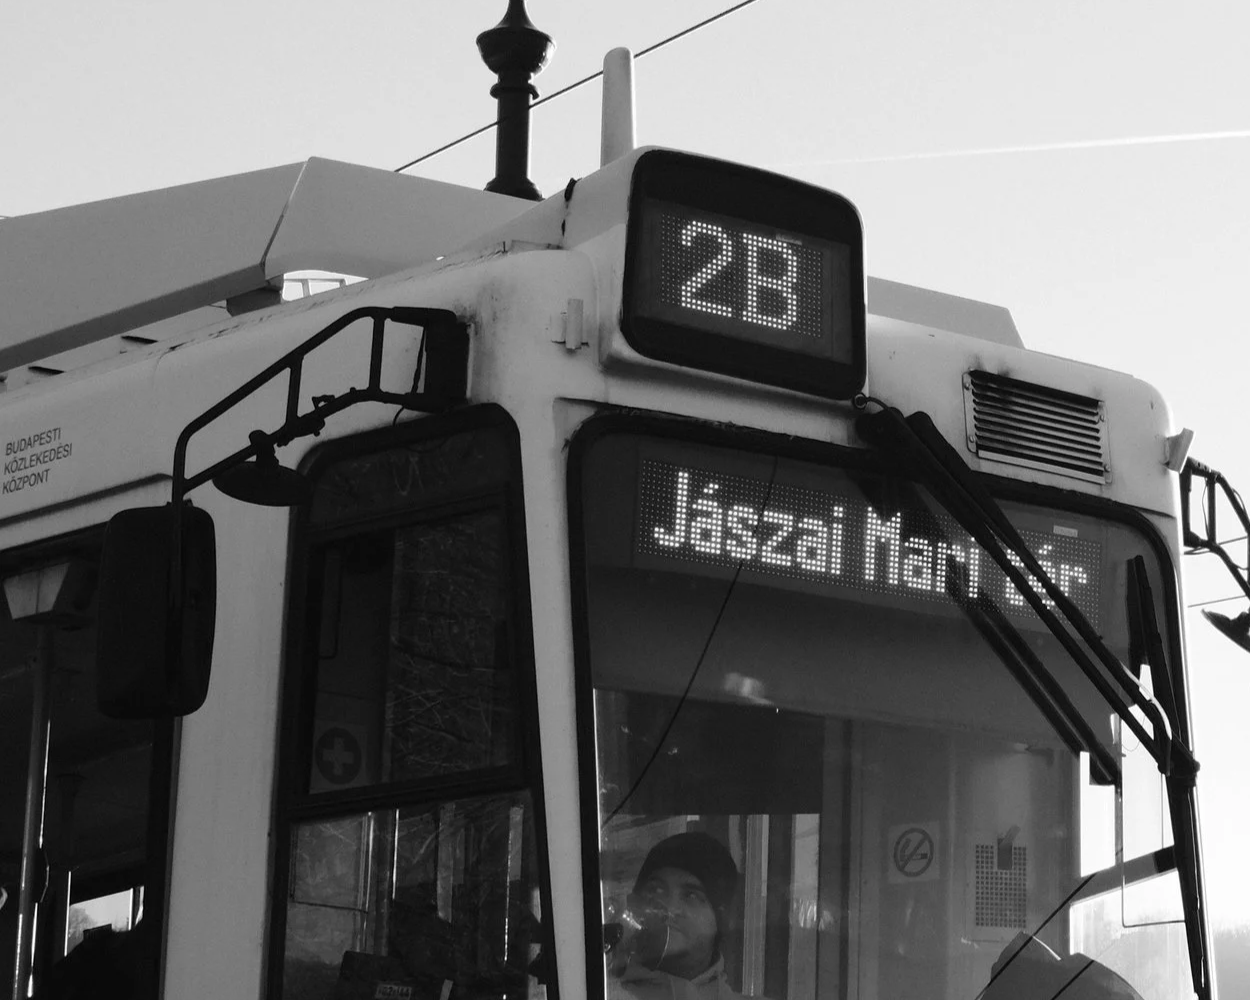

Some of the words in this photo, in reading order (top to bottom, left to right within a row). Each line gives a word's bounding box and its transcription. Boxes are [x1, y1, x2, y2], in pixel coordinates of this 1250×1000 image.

[681, 220, 797, 331] 2B
[5, 427, 62, 456] BUDAPESTI
[3, 442, 73, 475] KÖZLEKEDÉSI
[2, 468, 50, 494] KÖZPONT
[653, 471, 844, 575] Jászai
[865, 506, 979, 599] Mari
